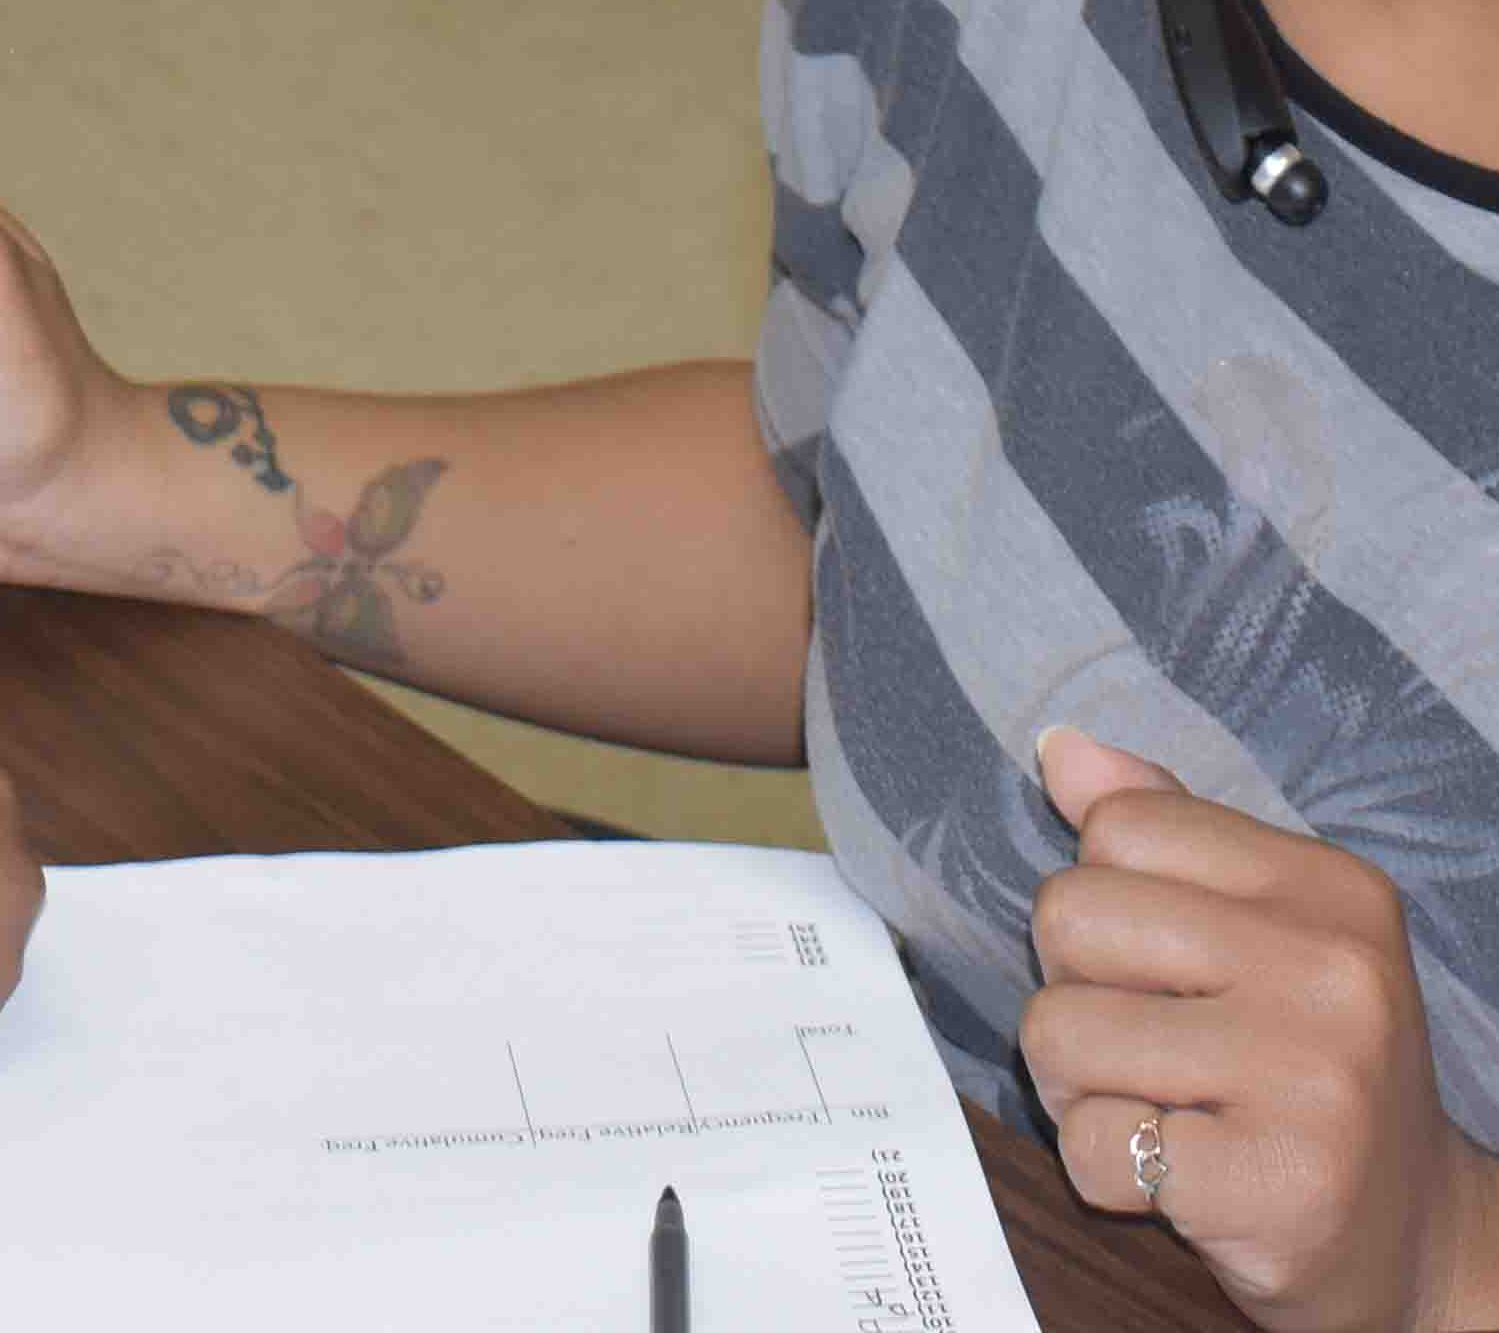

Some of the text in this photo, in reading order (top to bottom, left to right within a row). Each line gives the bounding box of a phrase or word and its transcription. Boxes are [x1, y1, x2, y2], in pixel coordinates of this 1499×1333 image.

[797, 1023, 858, 1037] Total
[699, 1110, 821, 1130] Frequency
[849, 1106, 890, 1119] Bin
[600, 1122, 695, 1140] Relative
[385, 1132, 524, 1148] Cumulative
